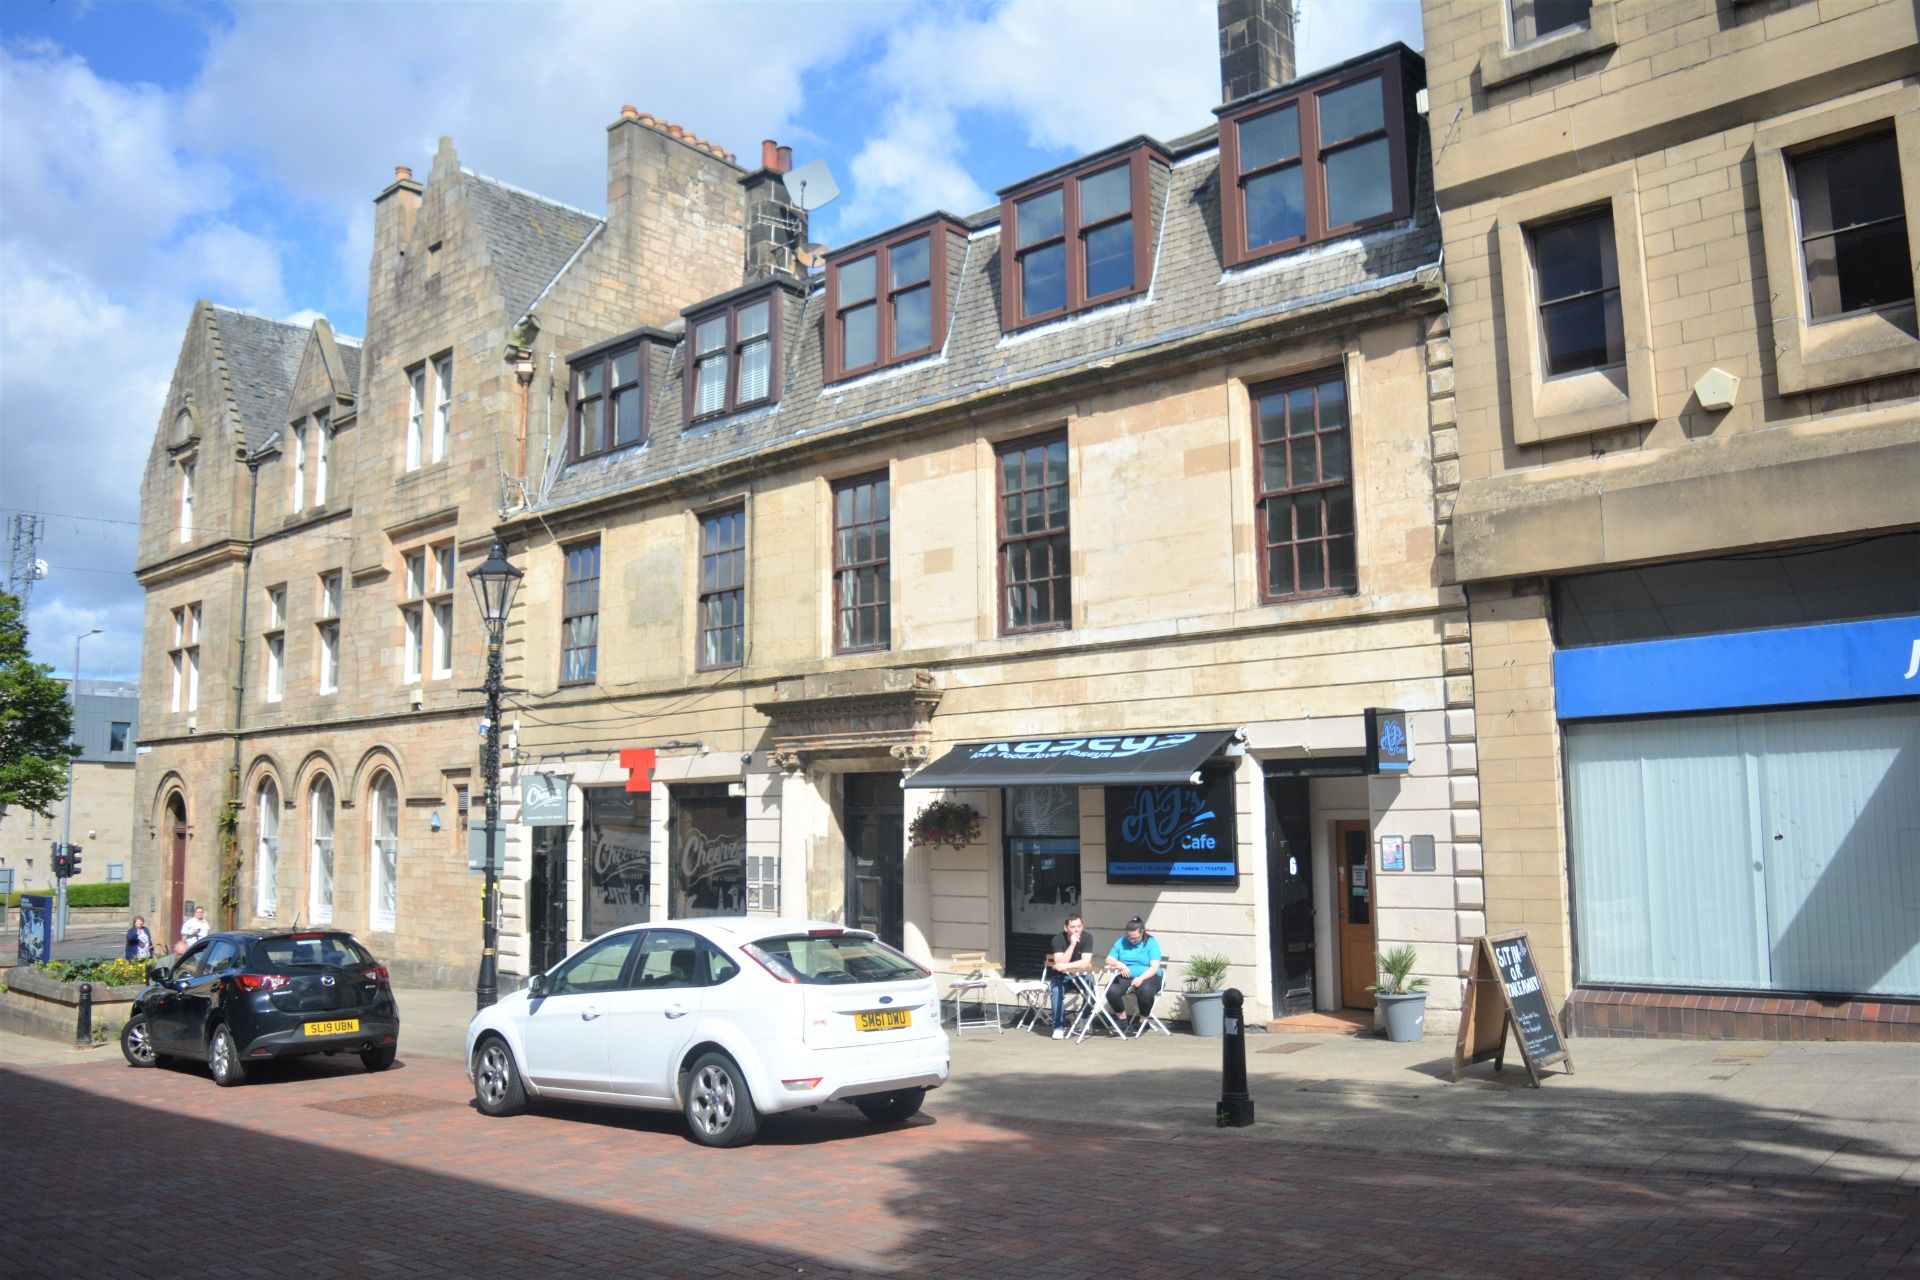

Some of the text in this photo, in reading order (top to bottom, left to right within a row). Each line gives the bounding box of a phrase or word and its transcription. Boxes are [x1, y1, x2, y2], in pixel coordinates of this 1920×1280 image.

[1181, 834, 1216, 850] Cafe
[1289, 856, 1298, 875] 6
[1496, 945, 1522, 967] SIT IN
[1510, 964, 1523, 981] OR
[1505, 976, 1540, 997] TAKEAWAY
[311, 1021, 353, 1034] SL19 UBN
[861, 1010, 906, 1028] SM61 DWU
